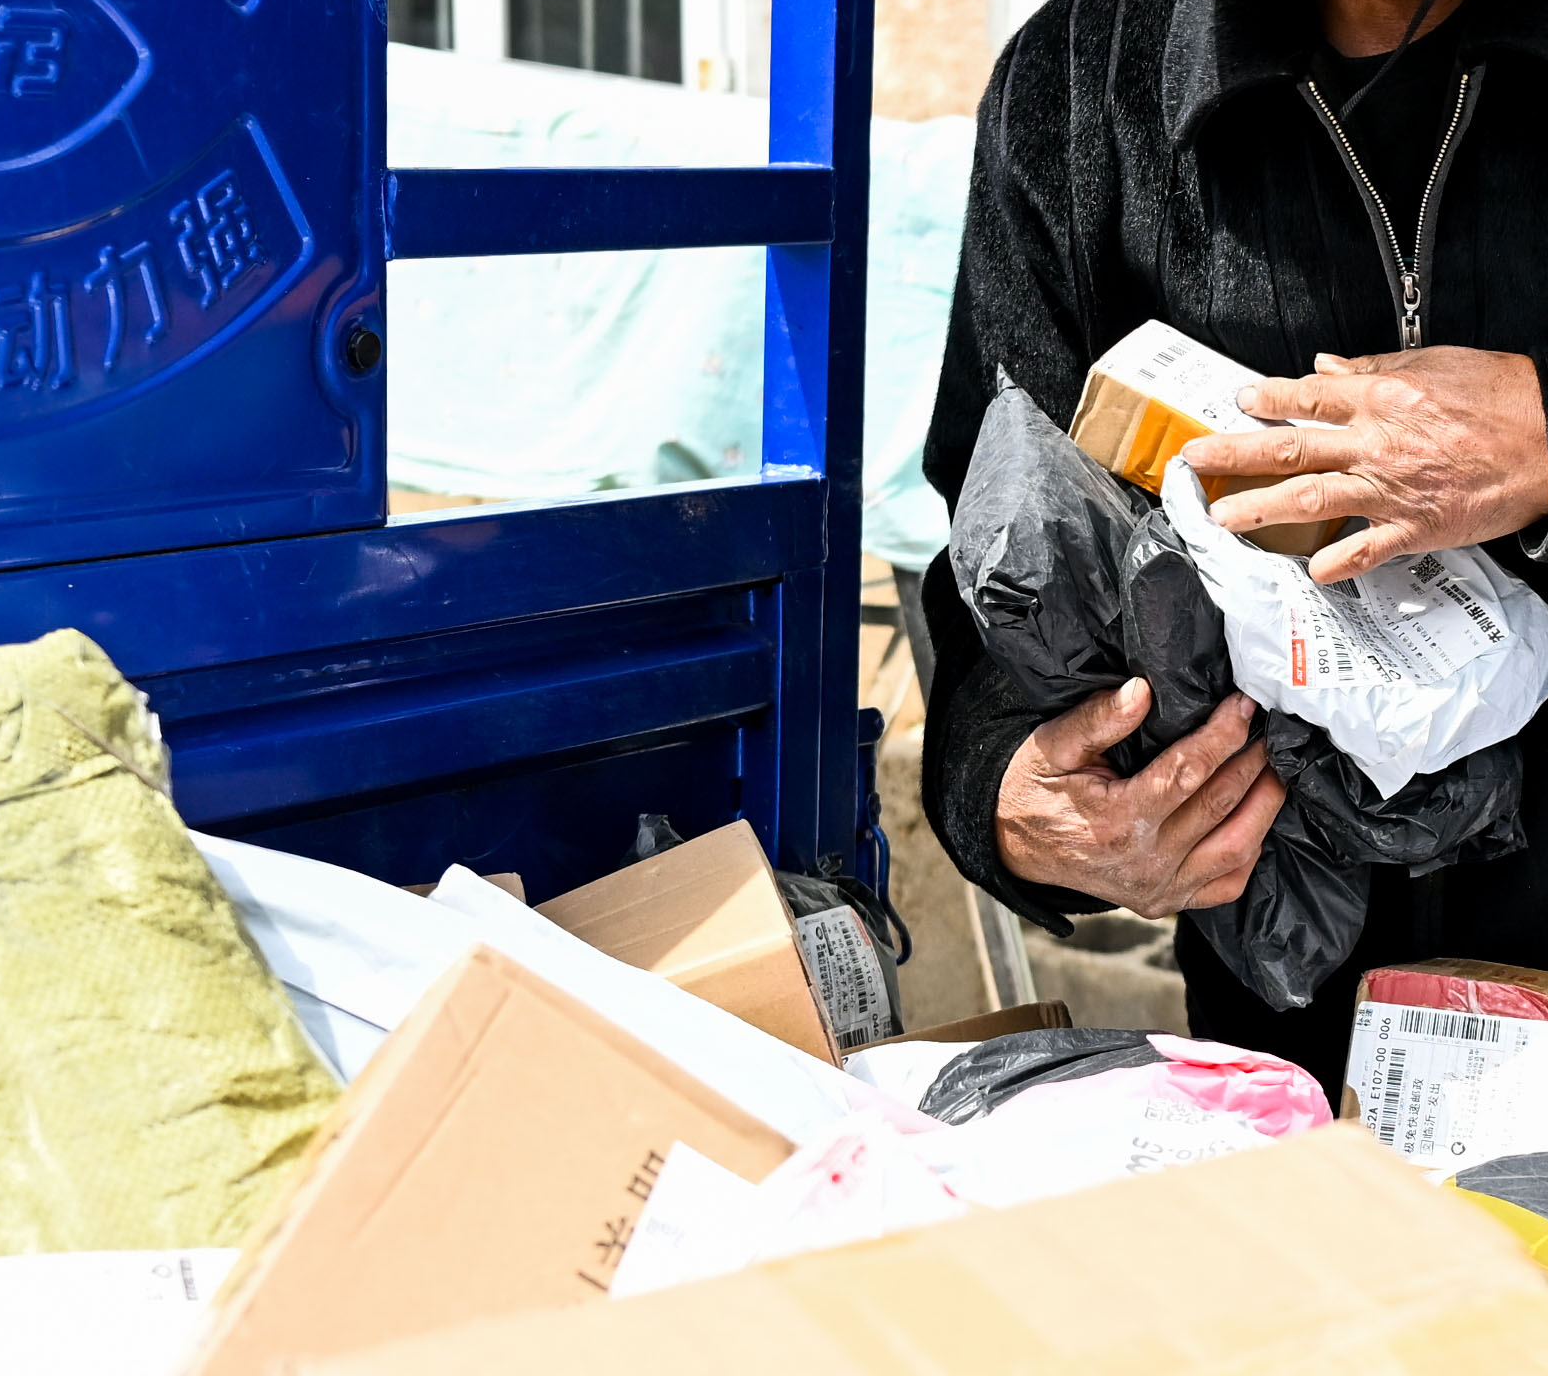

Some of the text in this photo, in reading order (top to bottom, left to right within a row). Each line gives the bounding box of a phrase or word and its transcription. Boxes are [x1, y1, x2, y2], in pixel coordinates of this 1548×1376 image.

[1318, 650, 1330, 674] 890
[1366, 1017, 1392, 1136] 52A E107-00 006
[1404, 1077, 1424, 1155] 极兔快递邮政
